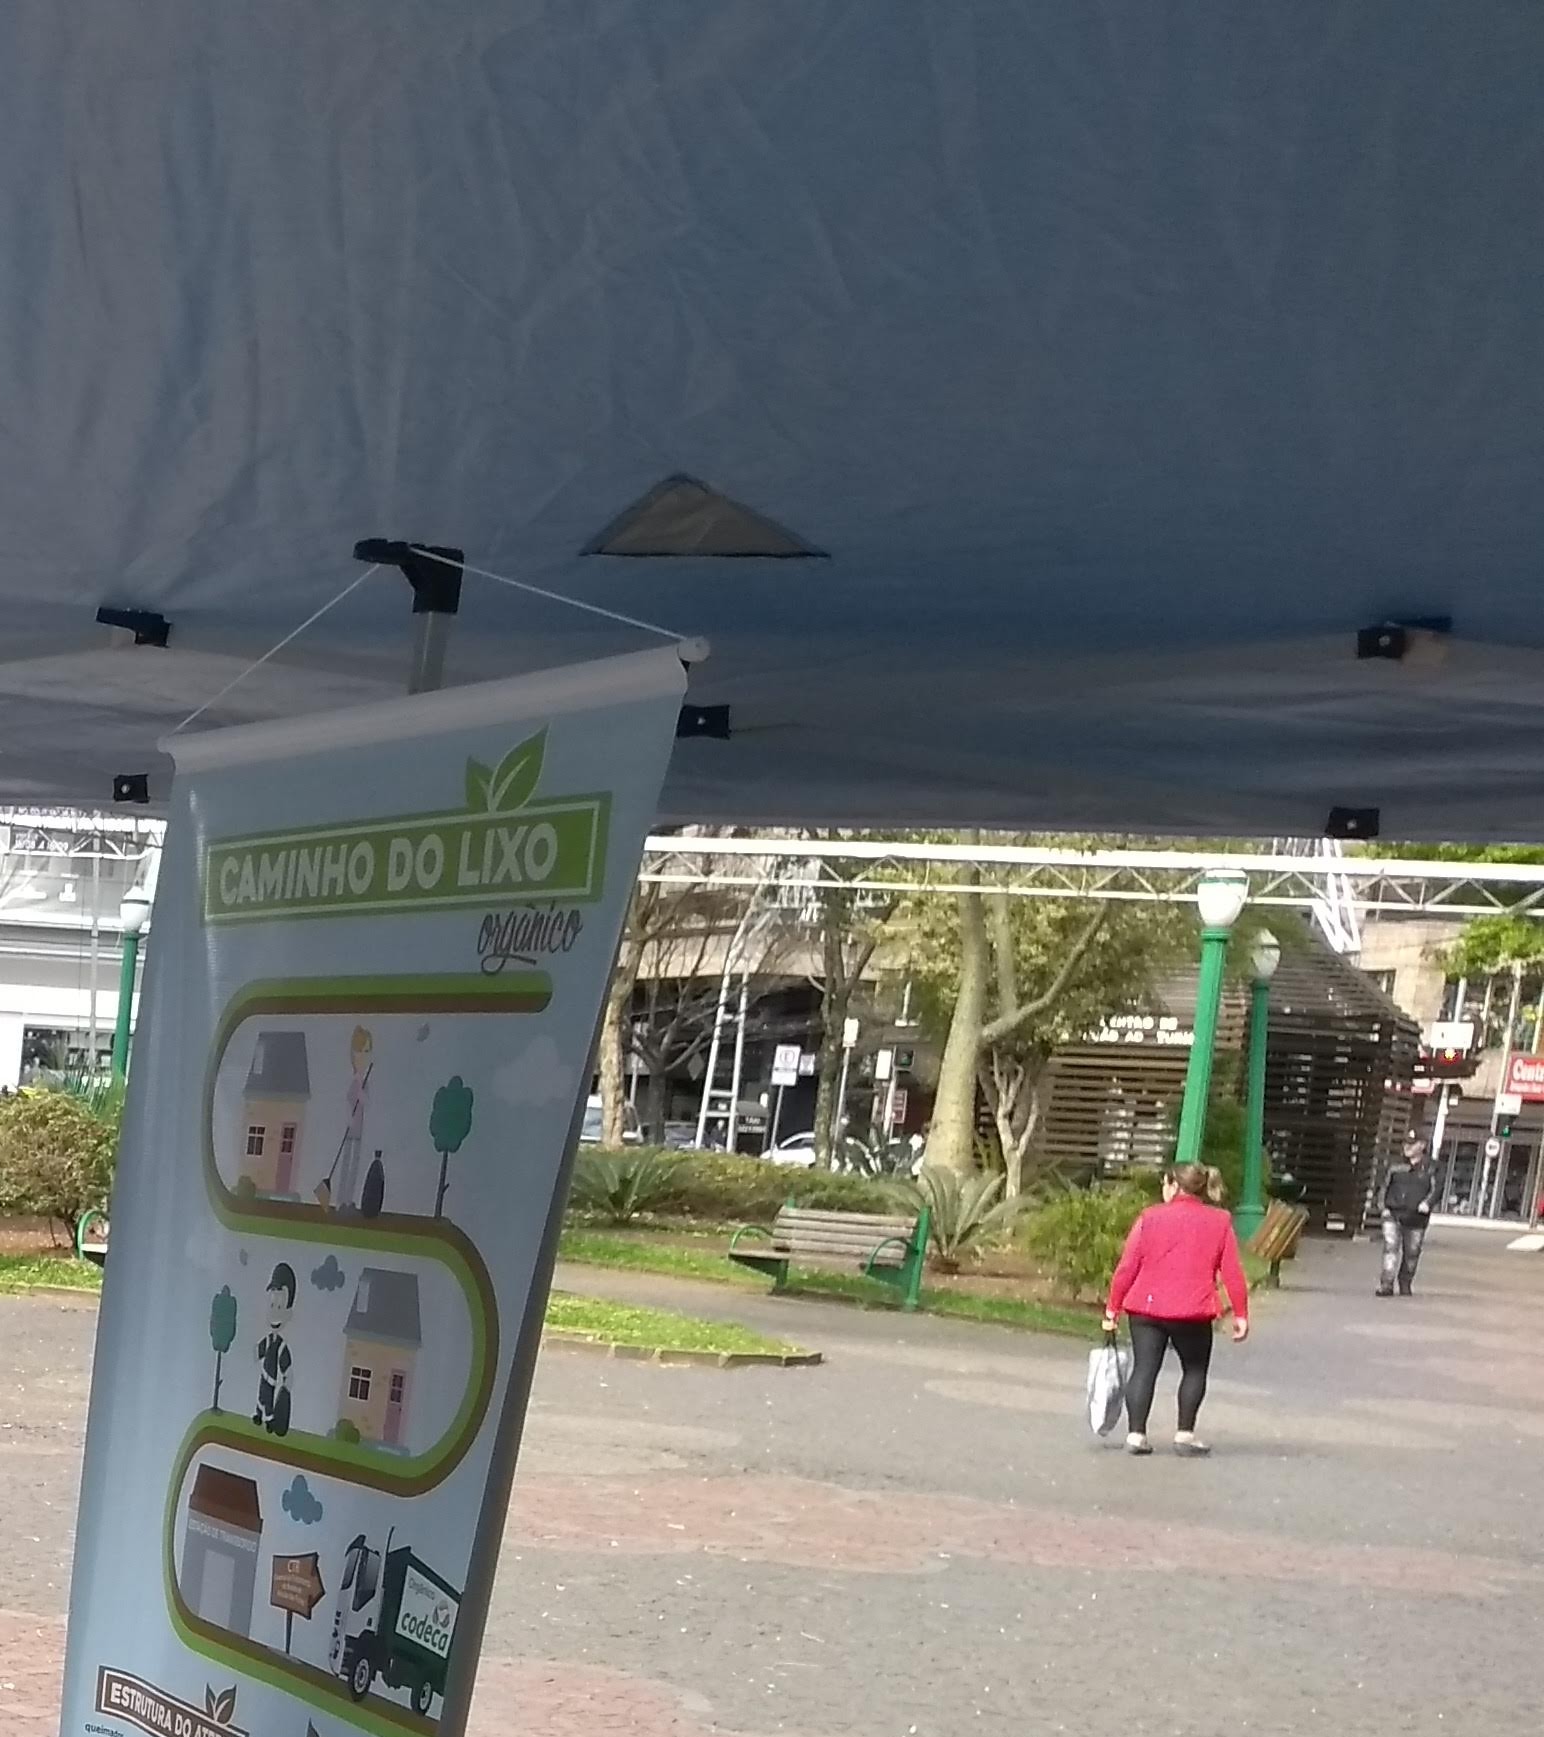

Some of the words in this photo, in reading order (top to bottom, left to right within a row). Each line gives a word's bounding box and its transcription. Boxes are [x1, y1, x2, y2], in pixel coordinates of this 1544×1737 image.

[220, 841, 374, 906] CAMINHO
[387, 834, 444, 892] DO
[457, 822, 557, 887] LIXO
[477, 901, 583, 976] orgânico
[402, 1611, 448, 1651] codeca
[111, 1682, 171, 1731] ESTRUTURA
